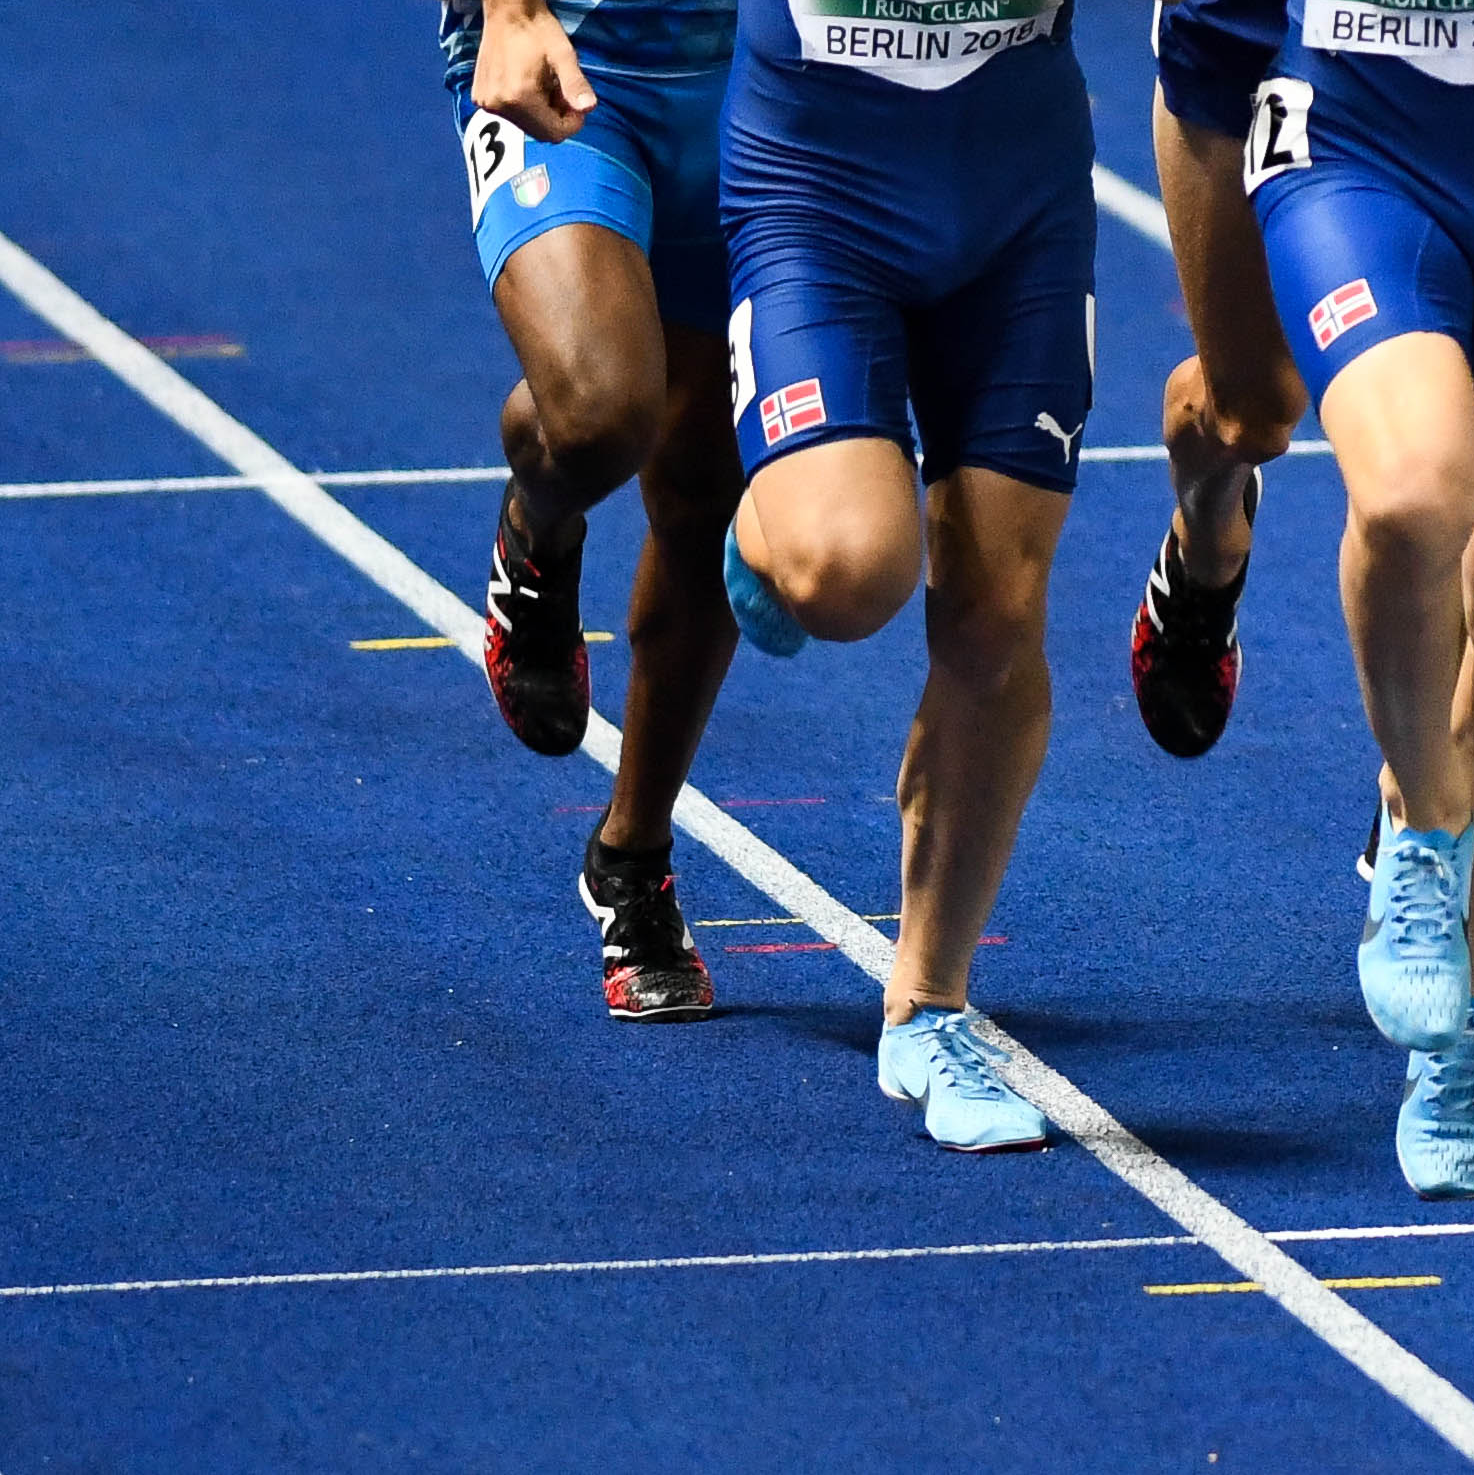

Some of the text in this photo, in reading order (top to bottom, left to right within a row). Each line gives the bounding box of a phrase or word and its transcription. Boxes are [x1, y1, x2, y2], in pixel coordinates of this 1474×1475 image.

[877, 0, 923, 22] RUN
[1332, 10, 1458, 48] BERLIN
[826, 21, 1034, 59] BERLIN 2018
[470, 121, 505, 198] 13
